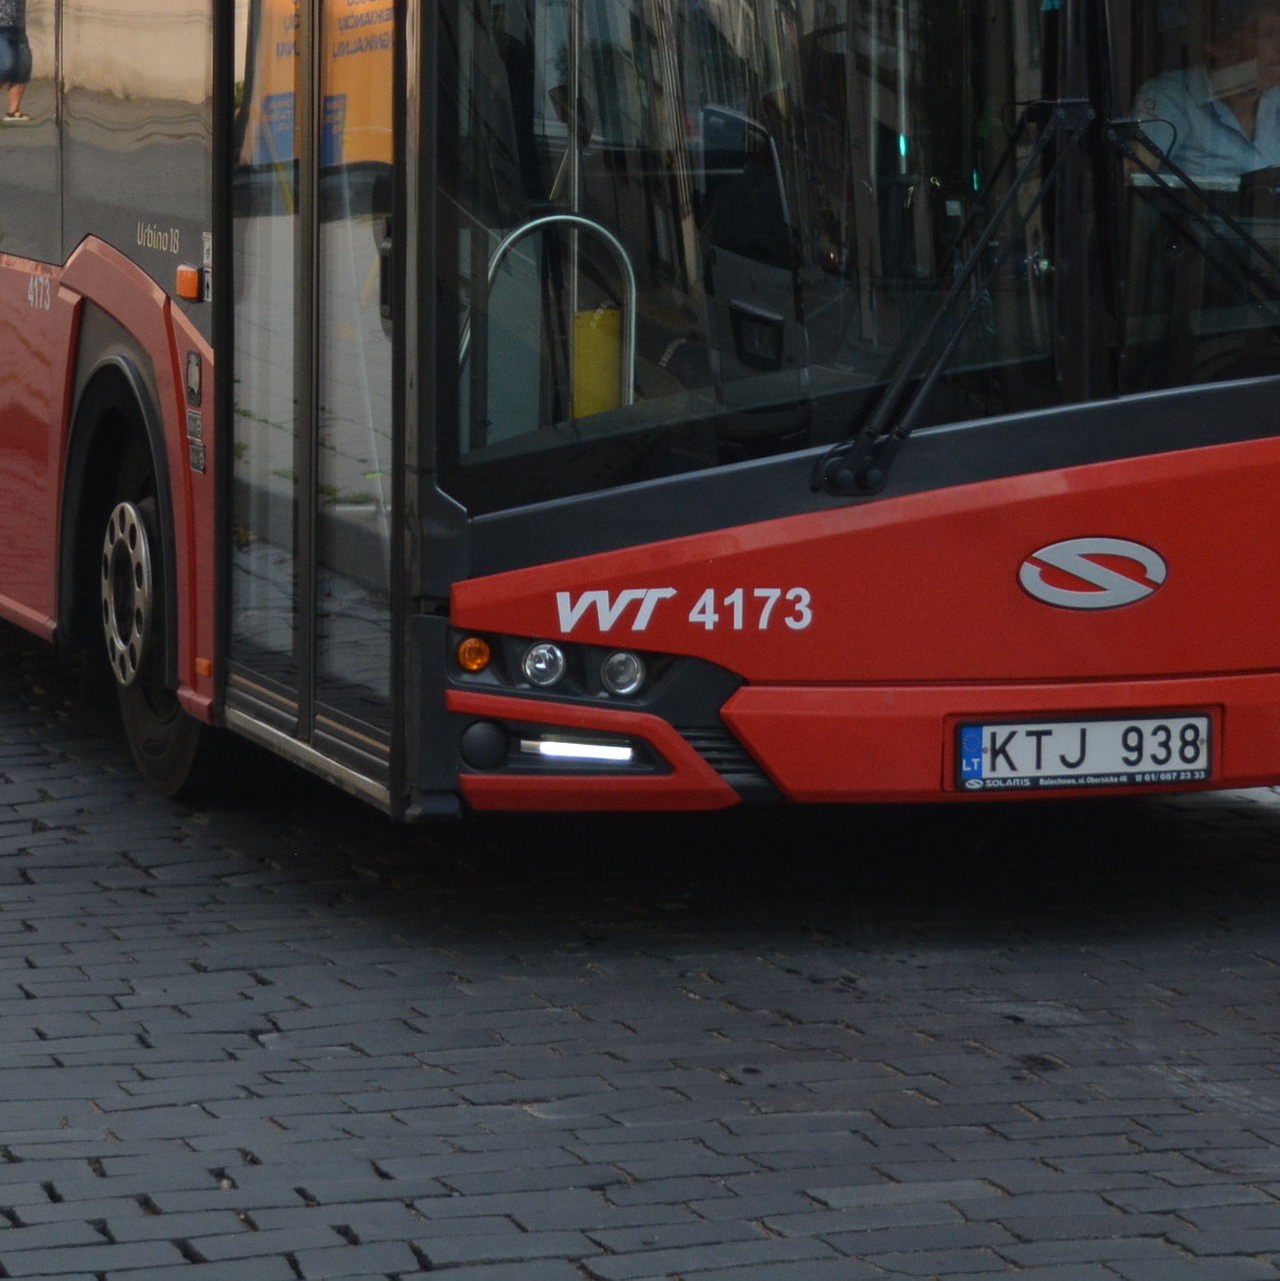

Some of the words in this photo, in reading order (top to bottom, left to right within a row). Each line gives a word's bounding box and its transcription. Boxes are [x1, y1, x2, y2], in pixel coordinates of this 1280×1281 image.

[137, 221, 168, 252] Urbino
[170, 227, 180, 254] 18
[27, 274, 51, 310] 4173
[556, 587, 678, 633] VVT
[688, 587, 813, 631] 4173
[989, 727, 1087, 772] KTJ
[1121, 723, 1201, 767] 938
[962, 759, 981, 771] LT
[985, 779, 1031, 788] SOLARIS
[1180, 771, 1191, 780] 23
[1193, 770, 1205, 779] 33
